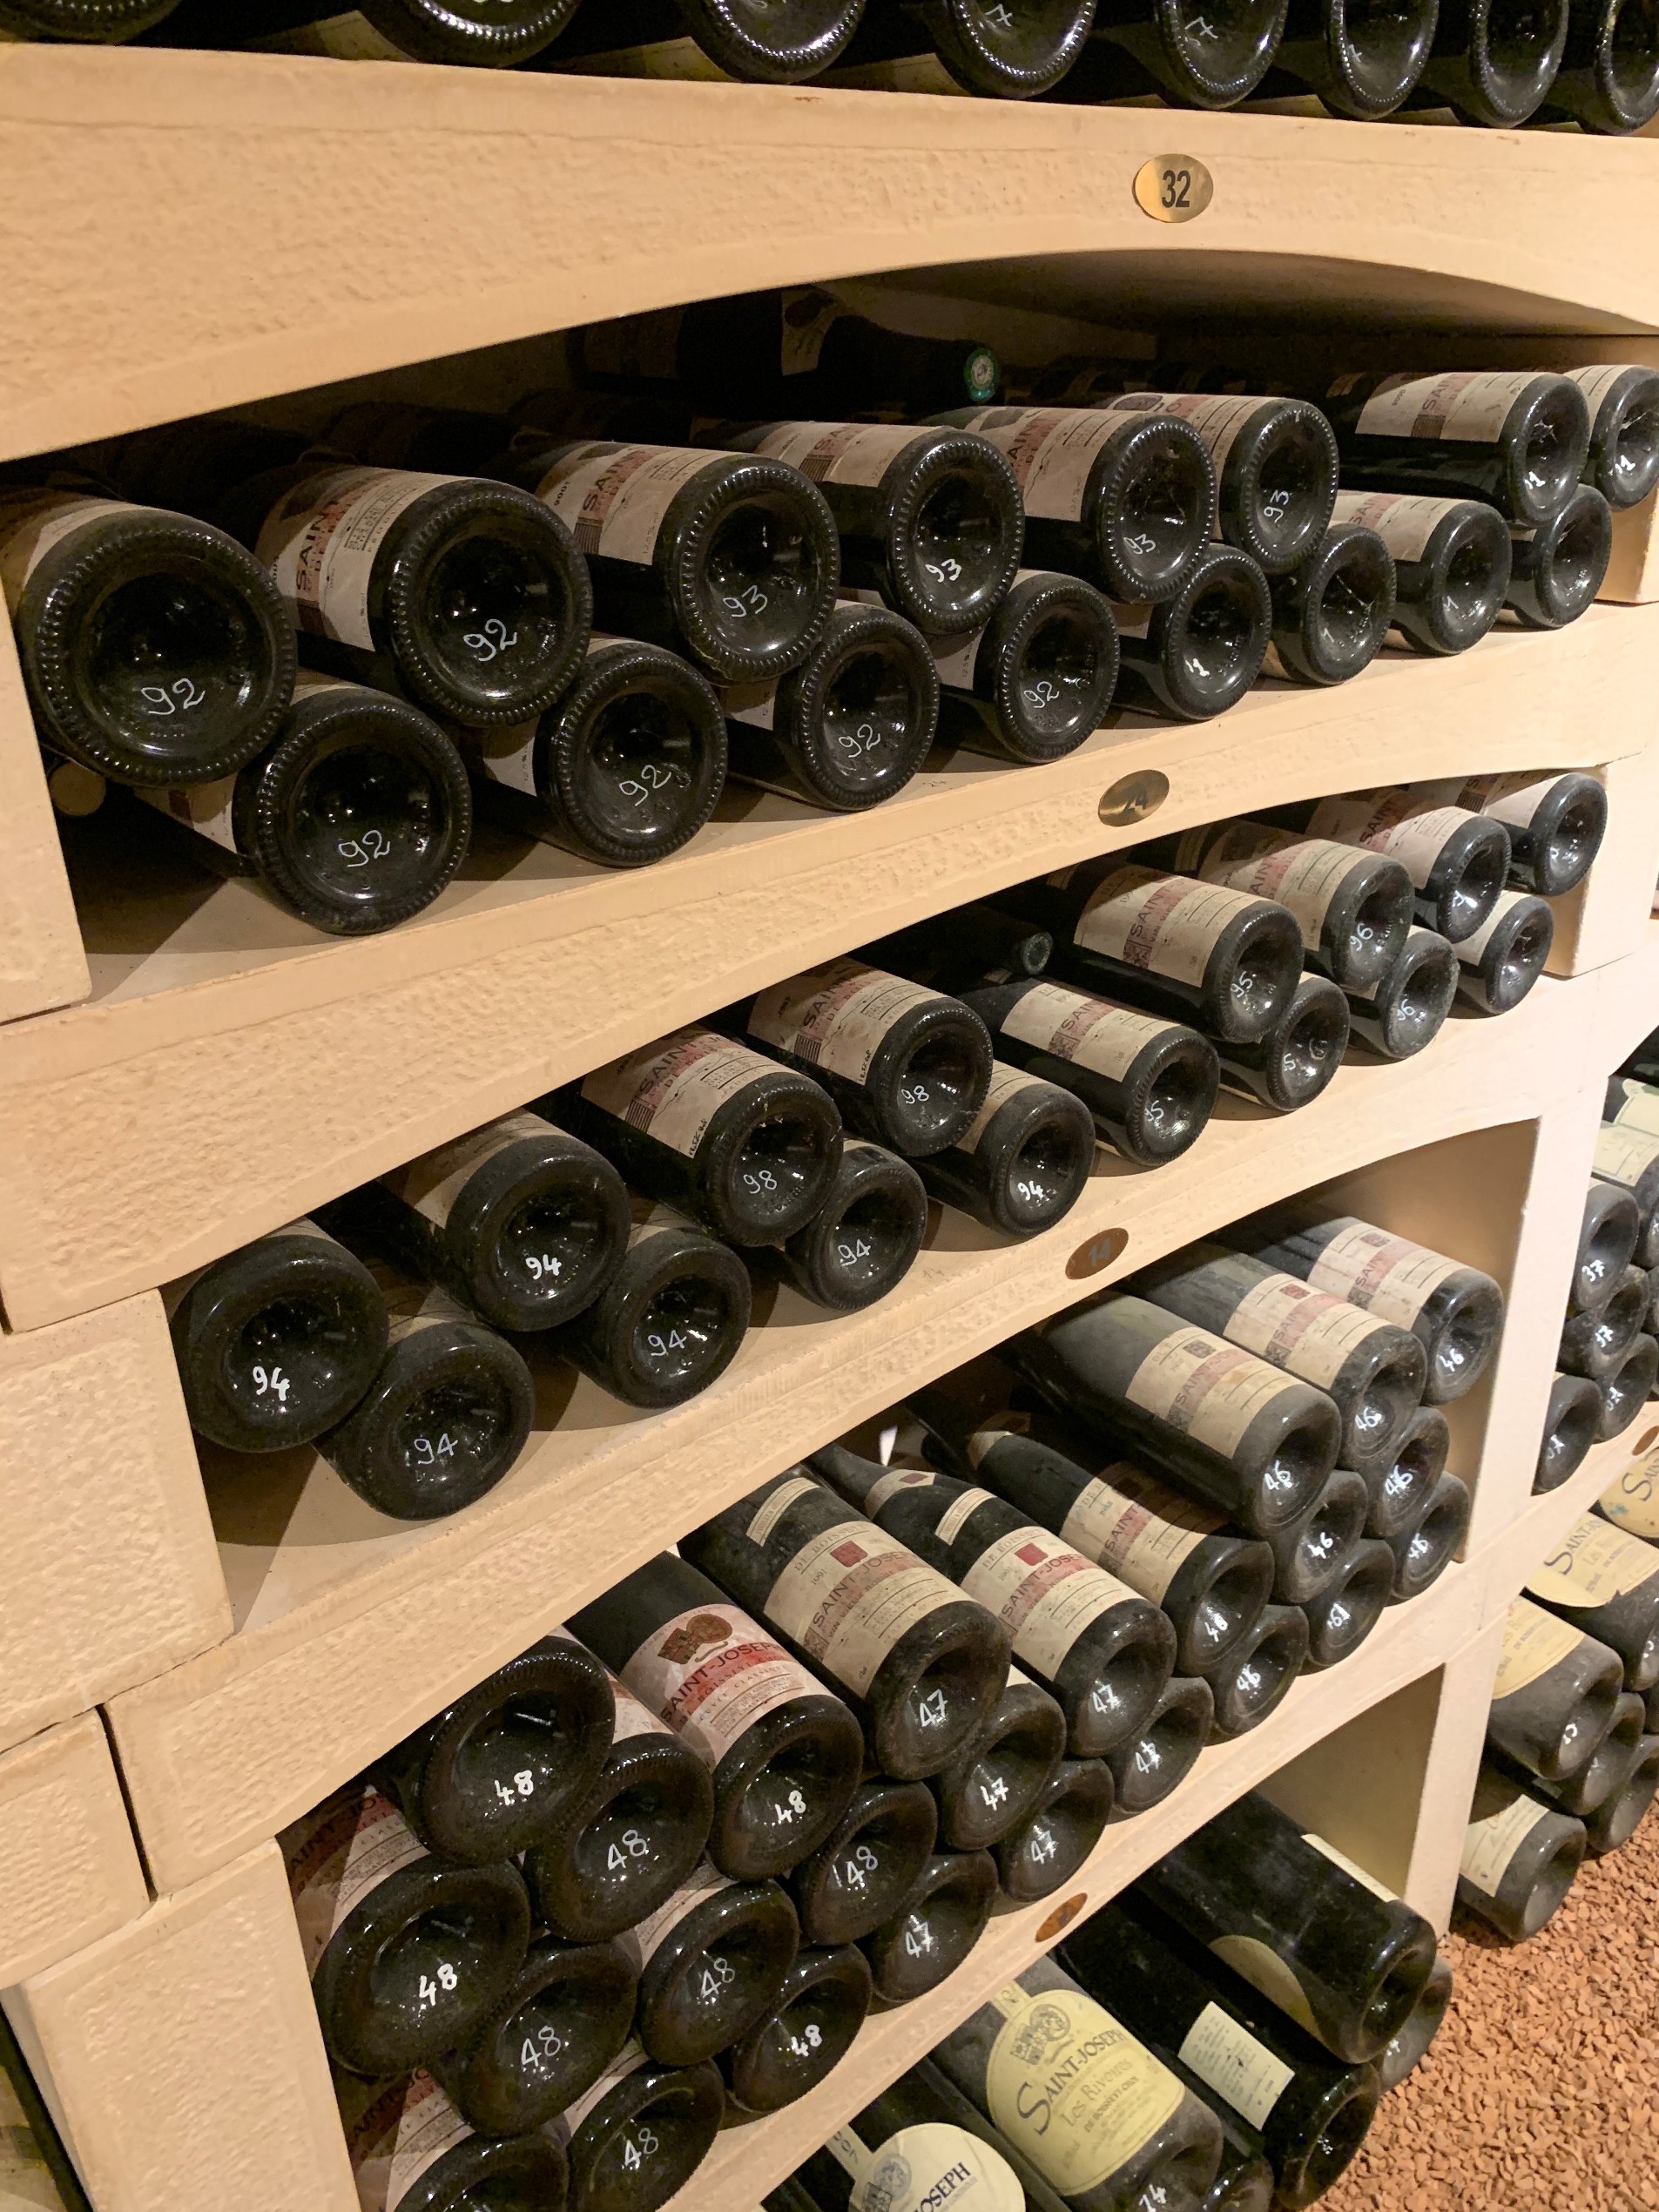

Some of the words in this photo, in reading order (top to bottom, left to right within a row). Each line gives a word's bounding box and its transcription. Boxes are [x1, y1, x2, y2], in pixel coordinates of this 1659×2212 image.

[1161, 170, 1190, 209] 32
[1263, 489, 1291, 523] 93
[1125, 533, 1157, 556] 93
[925, 558, 962, 583] 93
[723, 585, 769, 618] 93
[463, 617, 518, 663] 92
[140, 677, 206, 717] 92
[1023, 680, 1060, 710] 92
[837, 723, 882, 759] 92
[618, 764, 672, 806] 92
[338, 830, 391, 868] 92
[1230, 971, 1253, 999] 95
[900, 1084, 931, 1104] 98
[743, 1170, 778, 1195] 98
[1017, 1180, 1044, 1202] 94
[526, 1253, 562, 1280] 94
[838, 1239, 872, 1266] 94
[1581, 1259, 1606, 1283] 37
[647, 1329, 687, 1358] 94
[1439, 1351, 1464, 1373] 46
[253, 1366, 291, 1402] 94
[1354, 1408, 1381, 1431] 46
[413, 1433, 459, 1465] 94
[1263, 1462, 1293, 1493] 46
[1310, 1531, 1334, 1558] 46
[1205, 1613, 1228, 1642] 46
[920, 1690, 949, 1729] 47
[1093, 1687, 1118, 1714] 47
[494, 1770, 534, 1805] 48
[981, 1777, 1009, 1811] 47
[776, 1791, 807, 1824] 48
[607, 1830, 649, 1871] 48
[1030, 1831, 1057, 1865] 47
[904, 1920, 934, 1957] 47
[418, 1963, 458, 2005] 48
[698, 1958, 737, 2002] 48
[520, 2027, 562, 2067] 48
[789, 2024, 823, 2057] 48
[1015, 2028, 1130, 2136] SAINT-JOSEPH
[622, 2128, 660, 2170] 48
